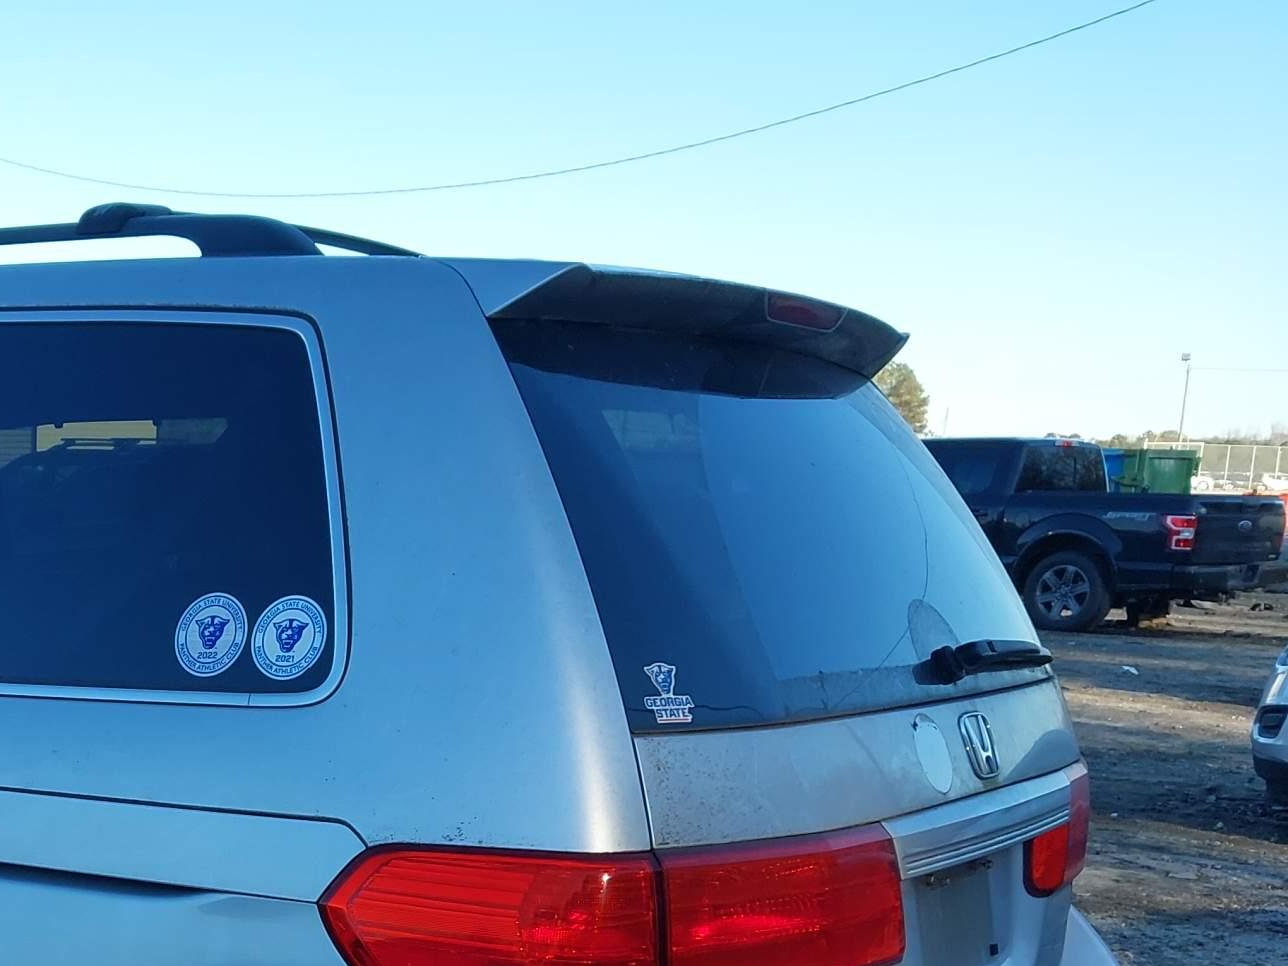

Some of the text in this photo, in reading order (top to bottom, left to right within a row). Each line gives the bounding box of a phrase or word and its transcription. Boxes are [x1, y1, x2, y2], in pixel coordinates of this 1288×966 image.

[181, 598, 243, 632] GEORGIA STATE UNIVERSITY
[258, 601, 322, 633] GEORGIA STATE UNIVERSITY
[179, 642, 240, 671] PANTHER ATHLETIC CLUB
[197, 651, 218, 660] 2022
[255, 646, 318, 674] PANTHER ATHLETIC CLUB
[275, 654, 295, 663] 2021
[646, 697, 691, 708] GEORGIA
[656, 708, 690, 718] STATE
